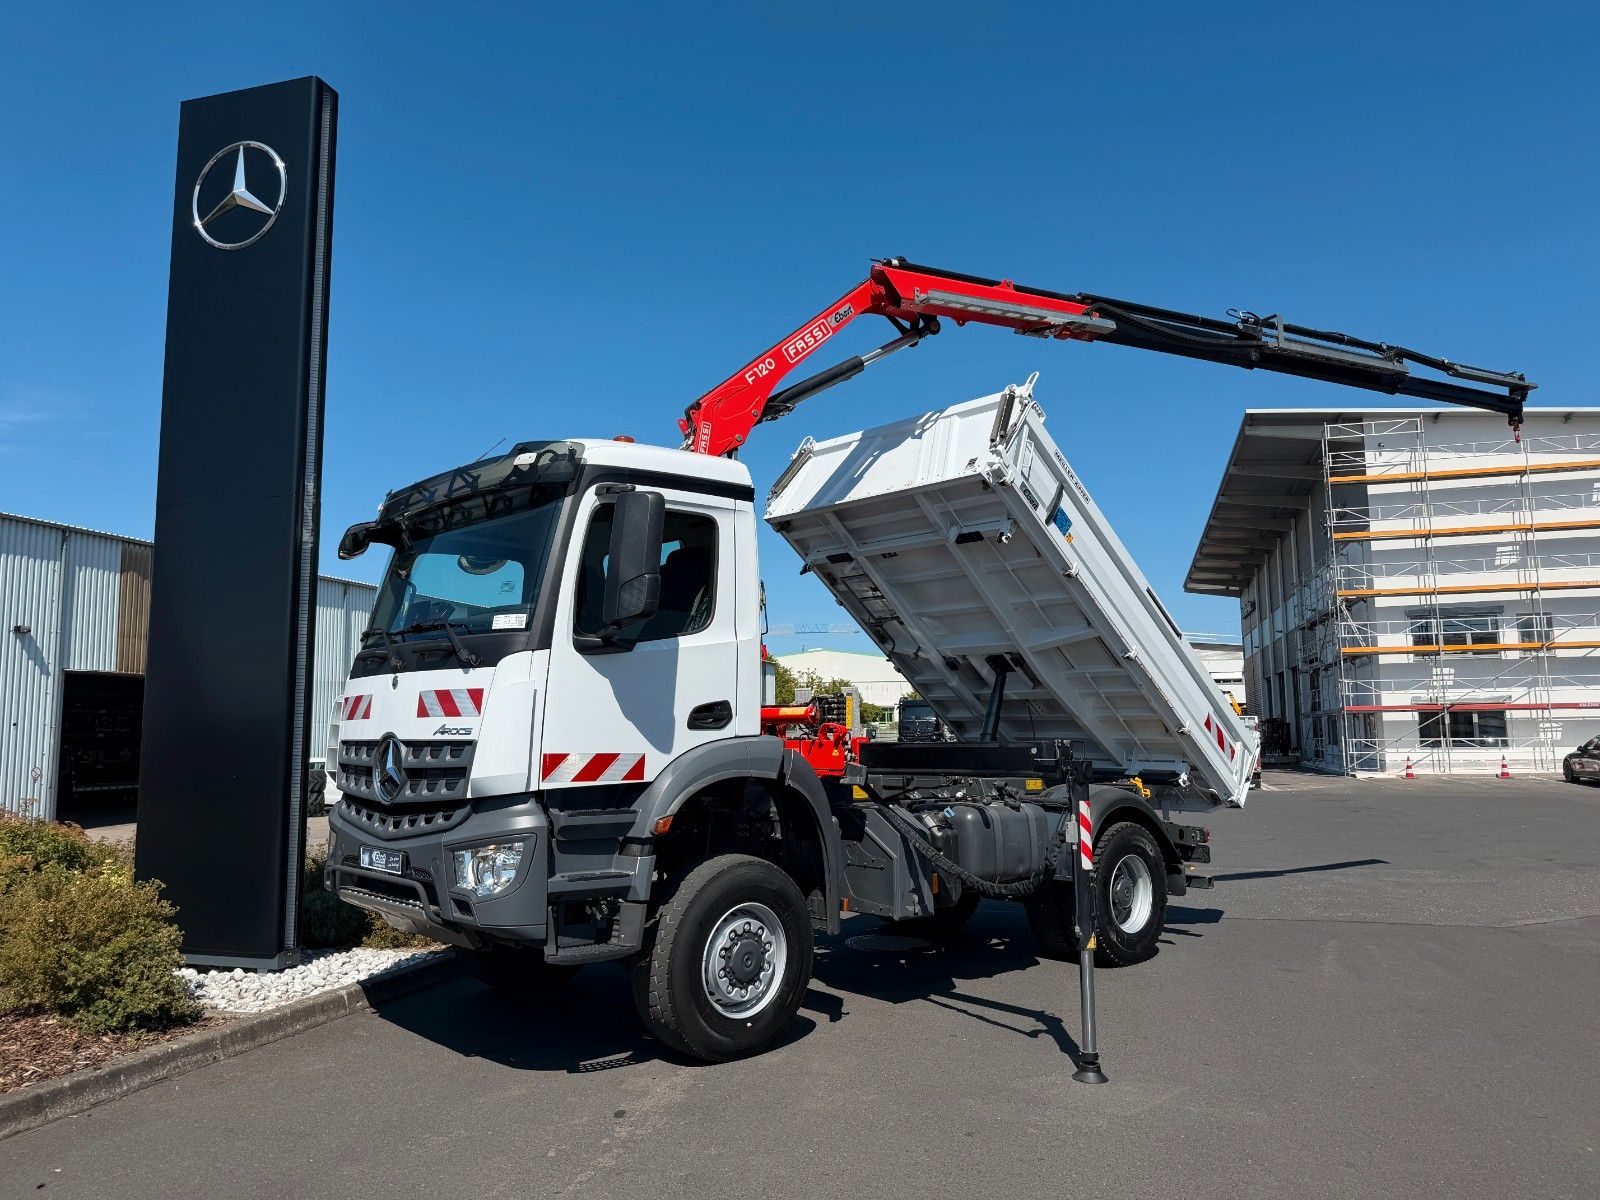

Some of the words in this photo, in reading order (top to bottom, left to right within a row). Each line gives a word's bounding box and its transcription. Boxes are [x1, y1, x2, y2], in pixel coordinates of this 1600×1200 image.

[788, 324, 828, 358] FASSI
[745, 358, 775, 384] F120
[700, 423, 710, 454] FASSI
[433, 723, 473, 736] AROCS
